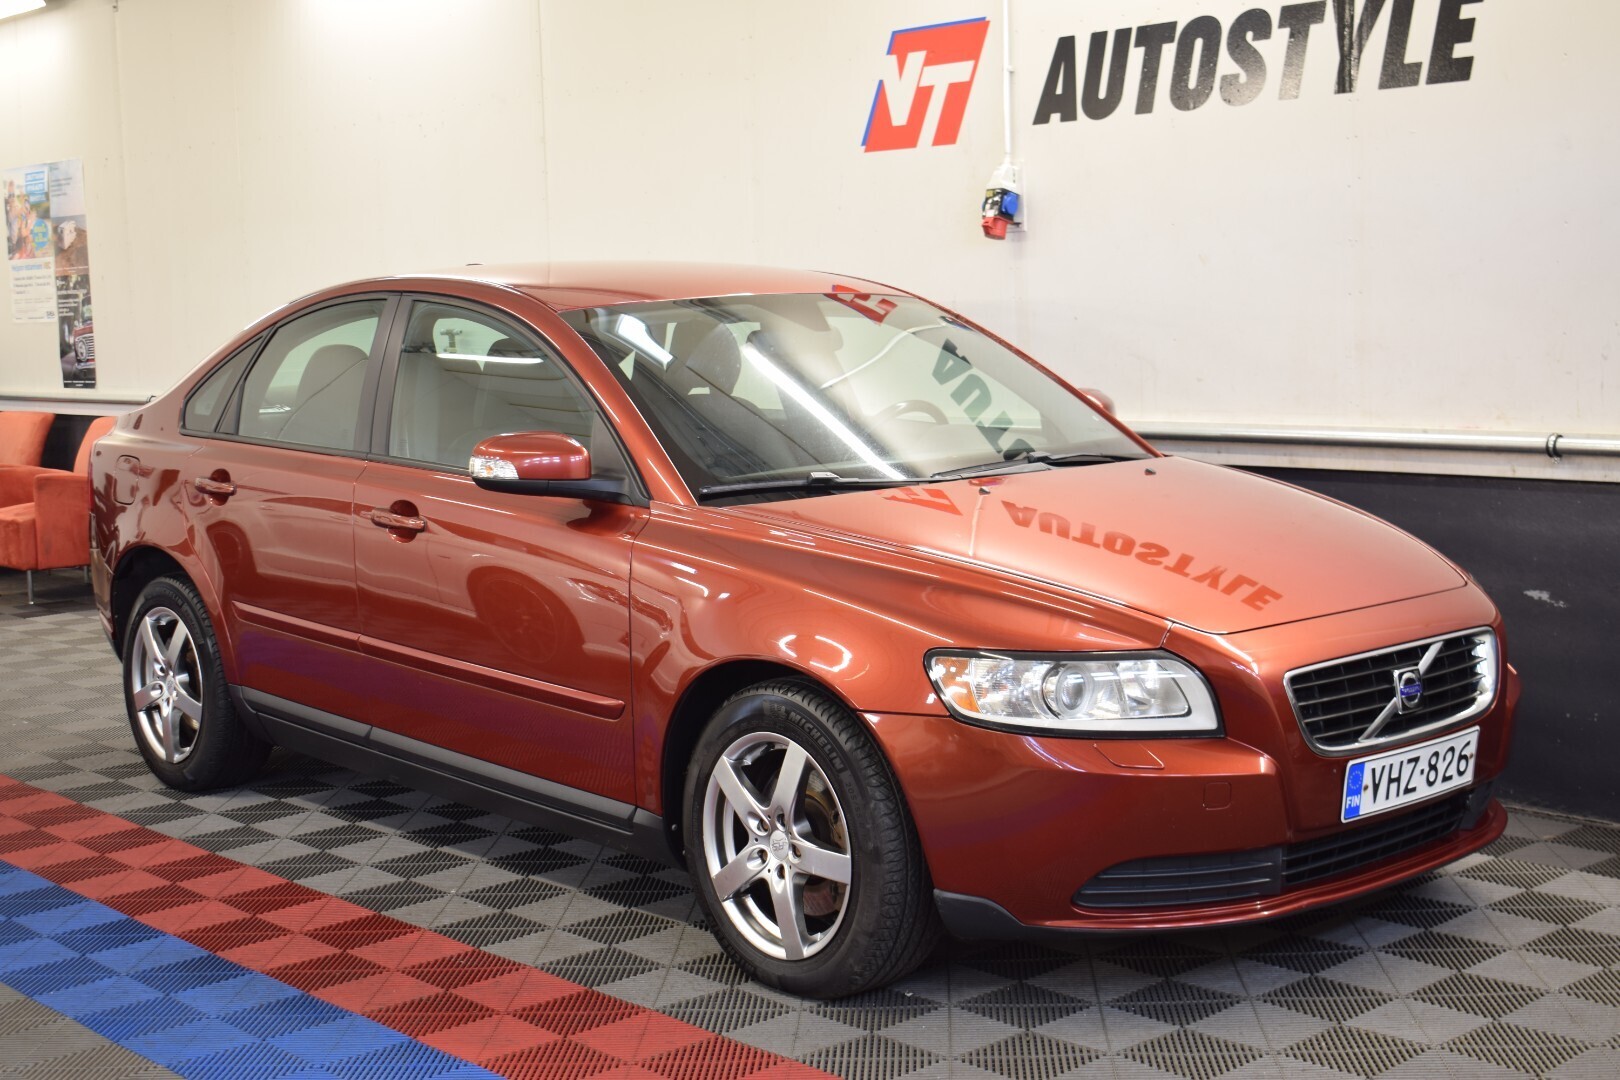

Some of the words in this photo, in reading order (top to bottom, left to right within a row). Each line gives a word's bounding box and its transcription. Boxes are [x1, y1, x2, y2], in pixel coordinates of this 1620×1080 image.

[1032, 0, 1484, 126] AUTOSTYLE
[787, 711, 845, 771] MICHELIN
[1371, 740, 1472, 804] VHZ-826
[1345, 794, 1361, 810] FIN
